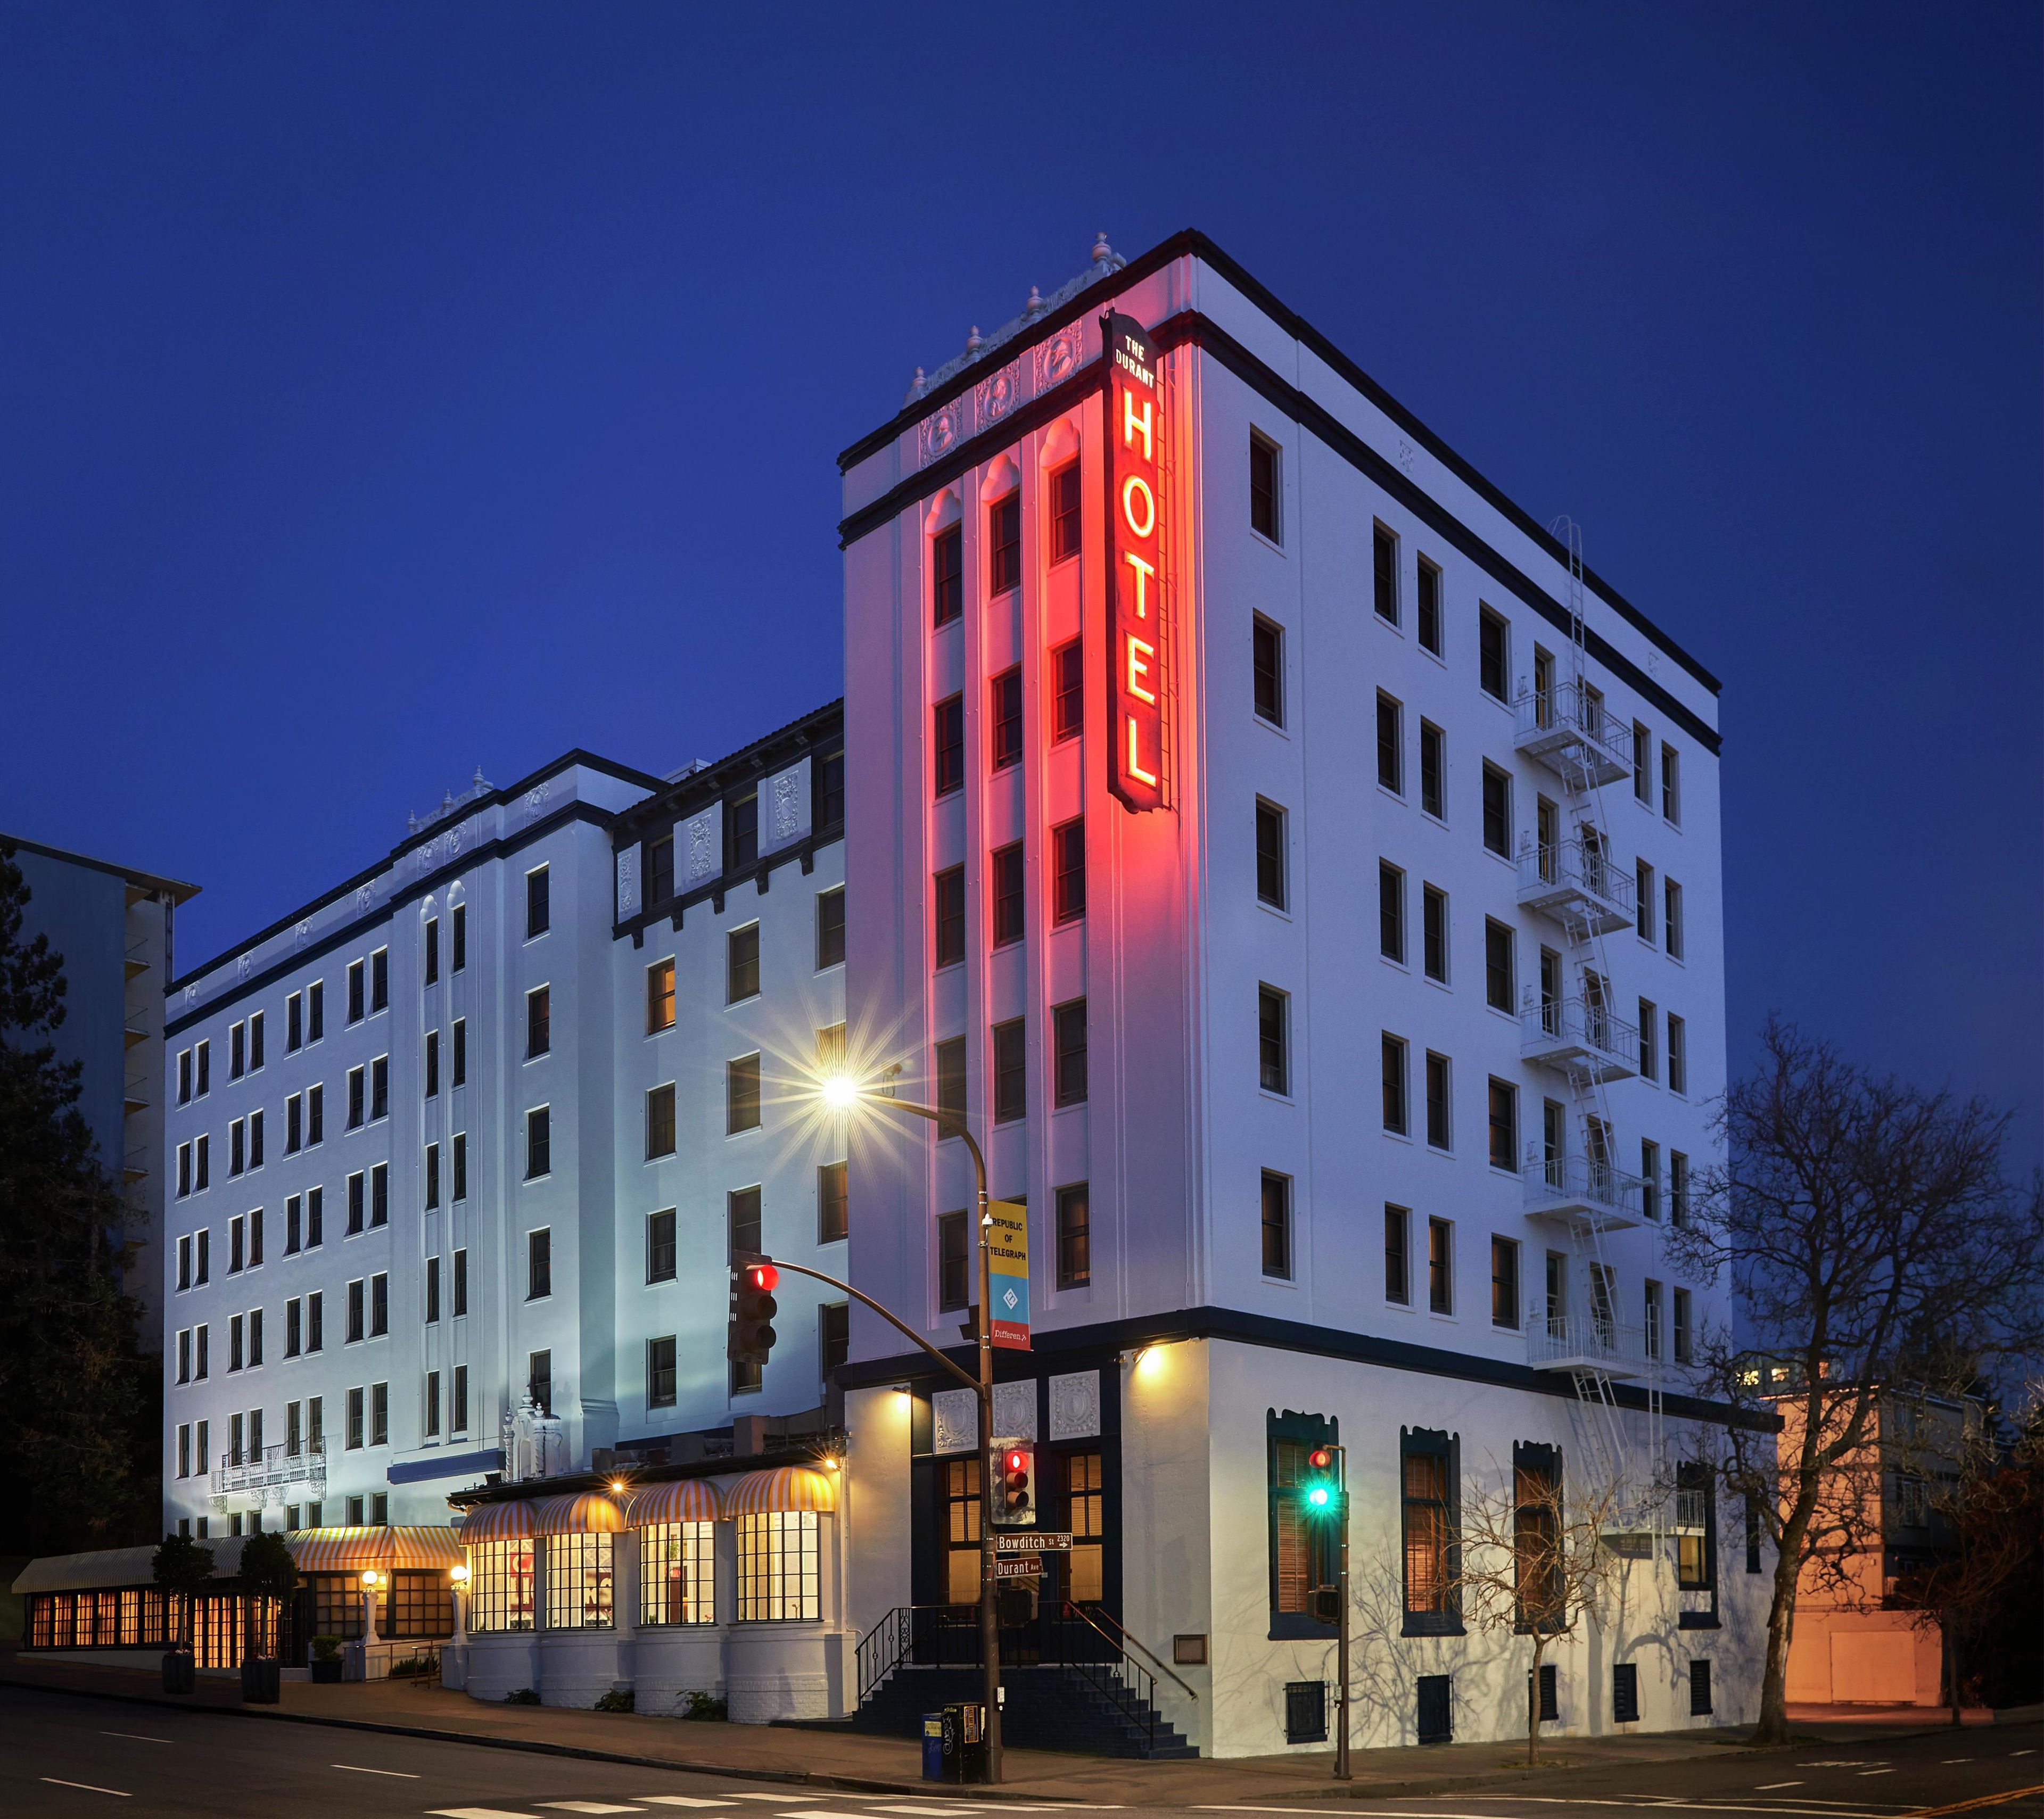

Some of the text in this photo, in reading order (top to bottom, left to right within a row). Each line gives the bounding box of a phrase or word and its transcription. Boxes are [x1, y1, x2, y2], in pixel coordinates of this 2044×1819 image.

[1125, 335, 1144, 362] THE
[1116, 349, 1154, 388] DURANT
[1124, 388, 1156, 787] HOTEL
[992, 1218, 1023, 1231] REPUBLIC
[1004, 1234, 1012, 1243] OF
[990, 1247, 1026, 1260] TELEGRAPH
[999, 1536, 1045, 1549] Bowditch
[998, 1561, 1028, 1575] Durant
